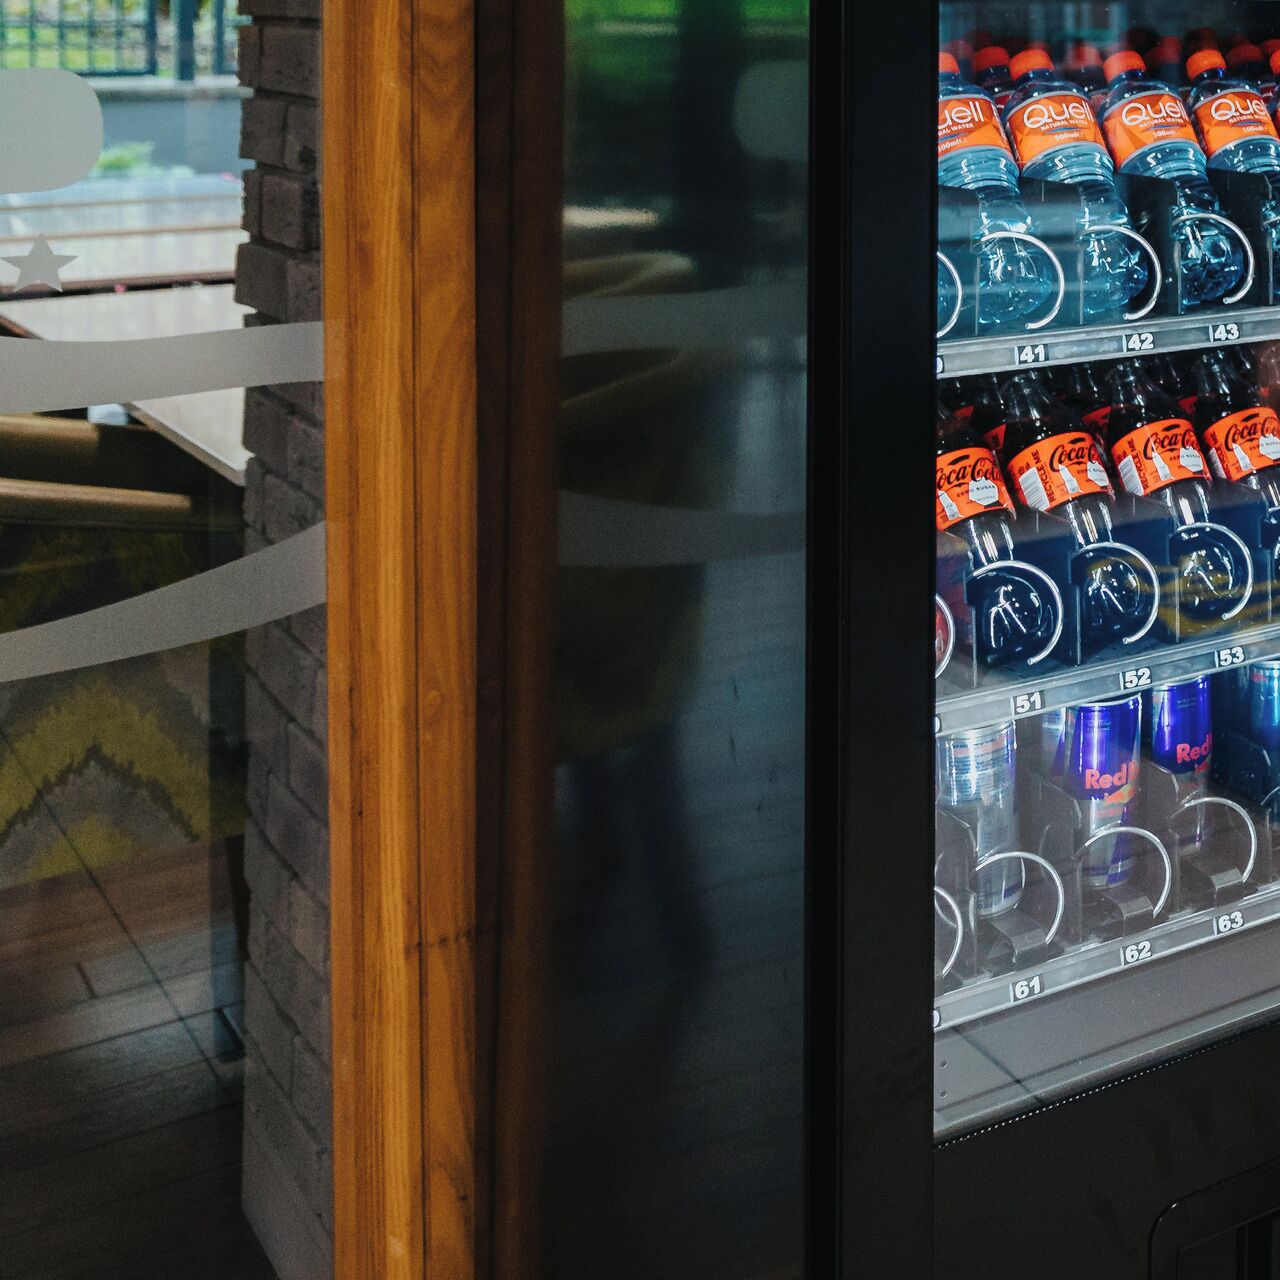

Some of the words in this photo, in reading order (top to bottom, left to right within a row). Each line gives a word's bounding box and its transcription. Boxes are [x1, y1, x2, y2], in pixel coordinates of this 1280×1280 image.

[938, 101, 985, 130] uell
[1023, 100, 1095, 130] Quell
[1121, 100, 1190, 126] Quell
[1128, 334, 1154, 350] 42
[1214, 324, 1240, 341] 43
[1020, 344, 1046, 362] 41
[1220, 648, 1245, 666] 53
[1125, 669, 1151, 687] 52
[1016, 692, 1042, 713] 51
[1085, 761, 1128, 790] Red
[1218, 911, 1244, 931] 63
[1125, 940, 1152, 963] 62
[1014, 976, 1042, 999] 61
